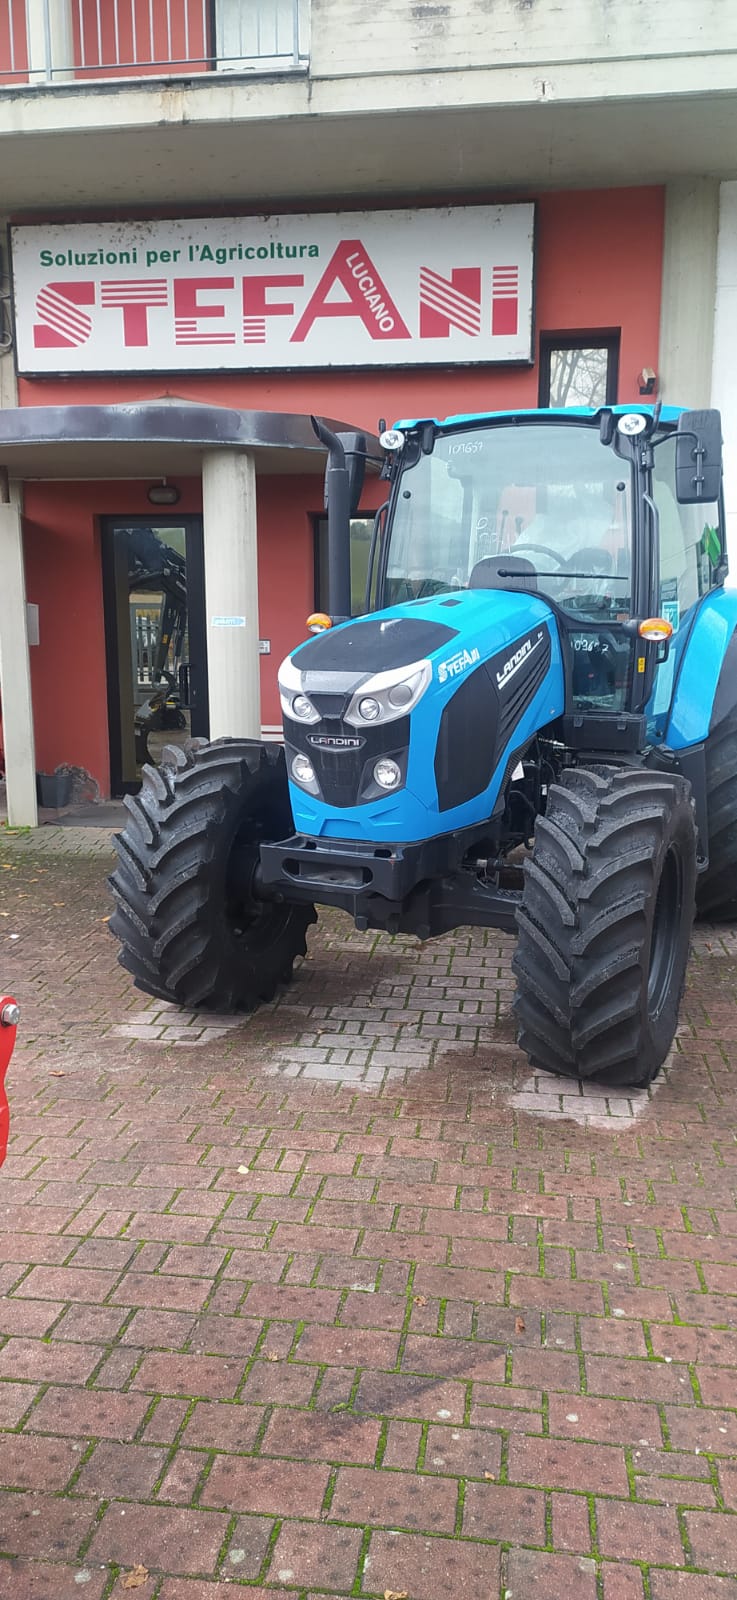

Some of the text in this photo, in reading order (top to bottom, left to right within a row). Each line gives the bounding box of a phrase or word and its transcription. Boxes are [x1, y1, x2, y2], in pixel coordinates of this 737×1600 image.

[39, 241, 320, 267] Soluzioni per l'Agricoltura
[33, 239, 519, 349] STEFANI
[345, 251, 395, 333] LUCIANO
[437, 647, 481, 684] STEFANI
[496, 639, 532, 682] LANDINI
[310, 736, 360, 746] LANDINI
